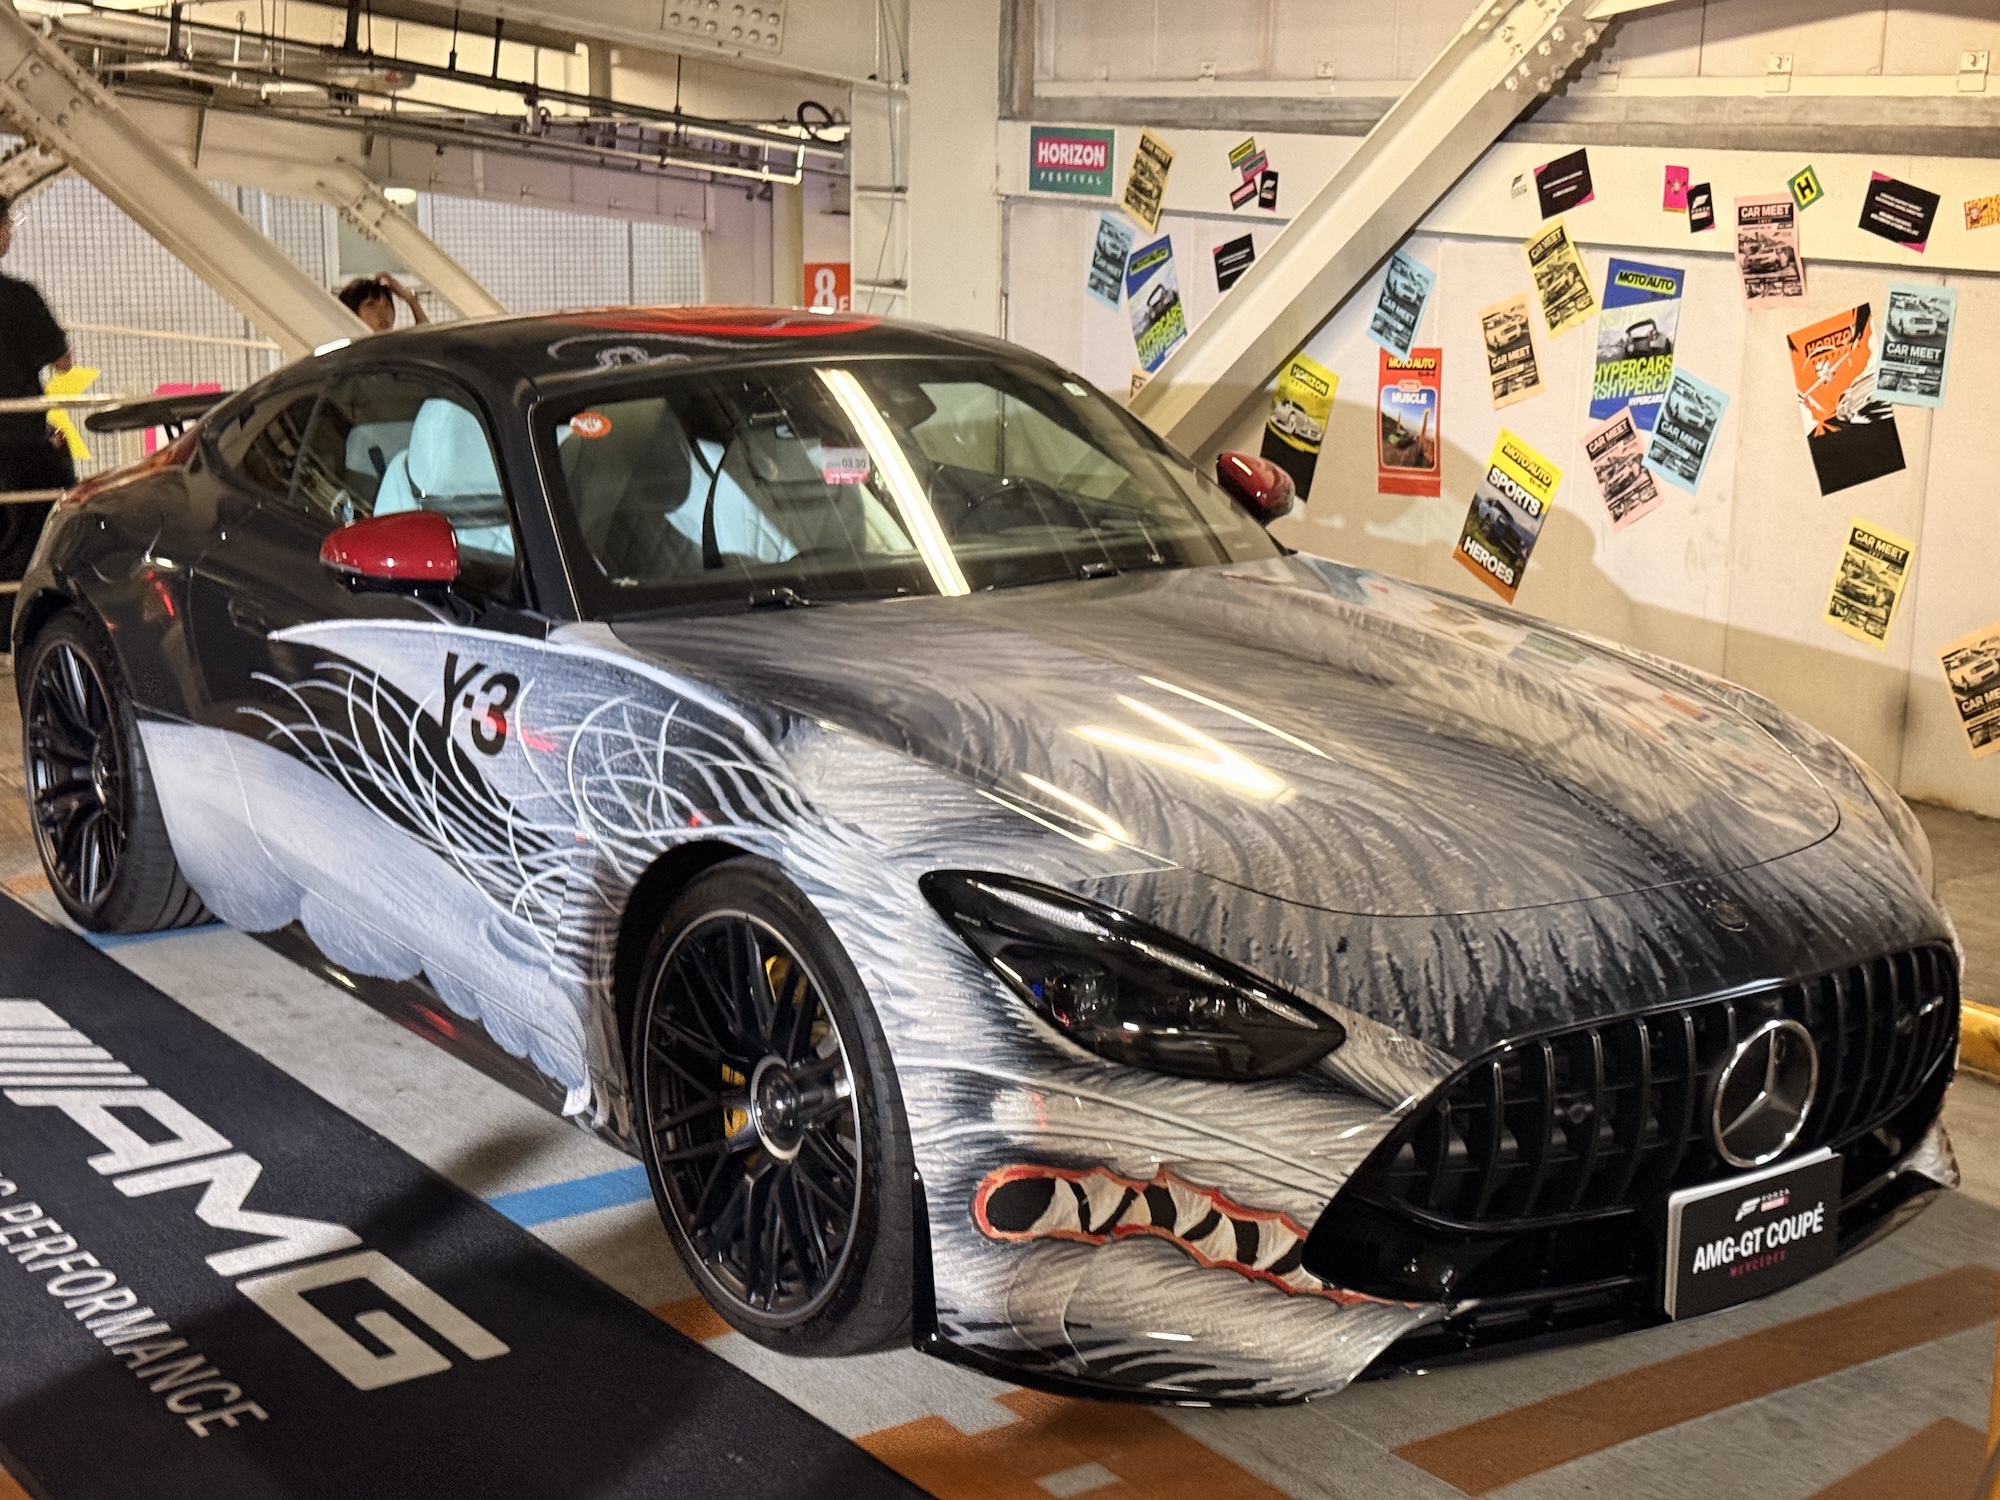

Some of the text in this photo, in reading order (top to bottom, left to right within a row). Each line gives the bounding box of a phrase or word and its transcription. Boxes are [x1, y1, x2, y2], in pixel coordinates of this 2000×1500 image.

[1038, 141, 1105, 167] HORIZON
[1040, 171, 1102, 186] FESTIVAL
[1796, 177, 1815, 199] H
[1741, 203, 1791, 218] CAR MEET
[1541, 229, 1562, 248] MEET
[1618, 271, 1674, 291] MOTO AUTO
[1382, 297, 1416, 326] CAR MEET
[1388, 357, 1436, 370] MOTO AUTO
[1491, 345, 1531, 369] CAR MEET
[1887, 342, 1942, 360] CAR MEET
[1292, 366, 1329, 395] HORIZON
[1594, 355, 1672, 381] HYPERCARS
[1391, 392, 1428, 404] MUSCLE
[1589, 421, 1628, 453] CAR MEET
[1661, 421, 1704, 453] CAR MEET
[1503, 443, 1530, 467] MOTO
[1527, 461, 1552, 486] AUTO
[1490, 467, 1541, 517] SPORTS
[1854, 530, 1876, 548] CAR
[1875, 540, 1906, 561] MEET
[1463, 536, 1515, 586] HEROES
[442, 652, 520, 757] Y-3
[1961, 696, 1984, 713] CAR
[3, 1088, 511, 1392] AMG
[1692, 1201, 1825, 1275] AMG-GT COUPÉ
[0, 1201, 269, 1437] PERFORMANCE
